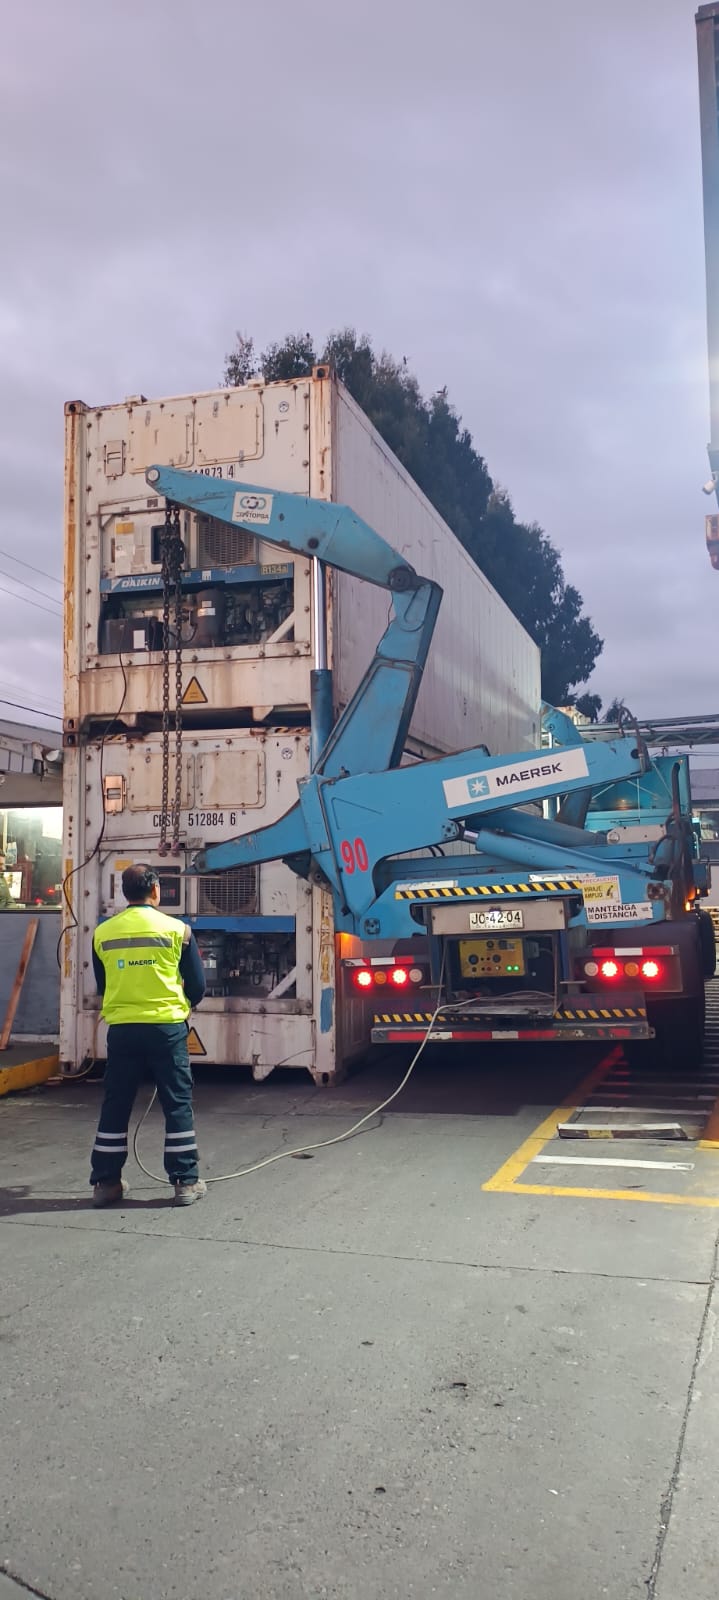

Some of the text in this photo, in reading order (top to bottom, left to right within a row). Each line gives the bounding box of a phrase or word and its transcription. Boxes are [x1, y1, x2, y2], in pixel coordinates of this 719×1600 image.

[121, 577, 160, 588] DAIKIN
[496, 763, 562, 786] MAERSK
[188, 812, 224, 826] 512884
[230, 812, 236, 825] 6
[341, 837, 368, 875] 90
[588, 904, 637, 913] MANTENGA
[594, 911, 638, 920] DISTANCIA
